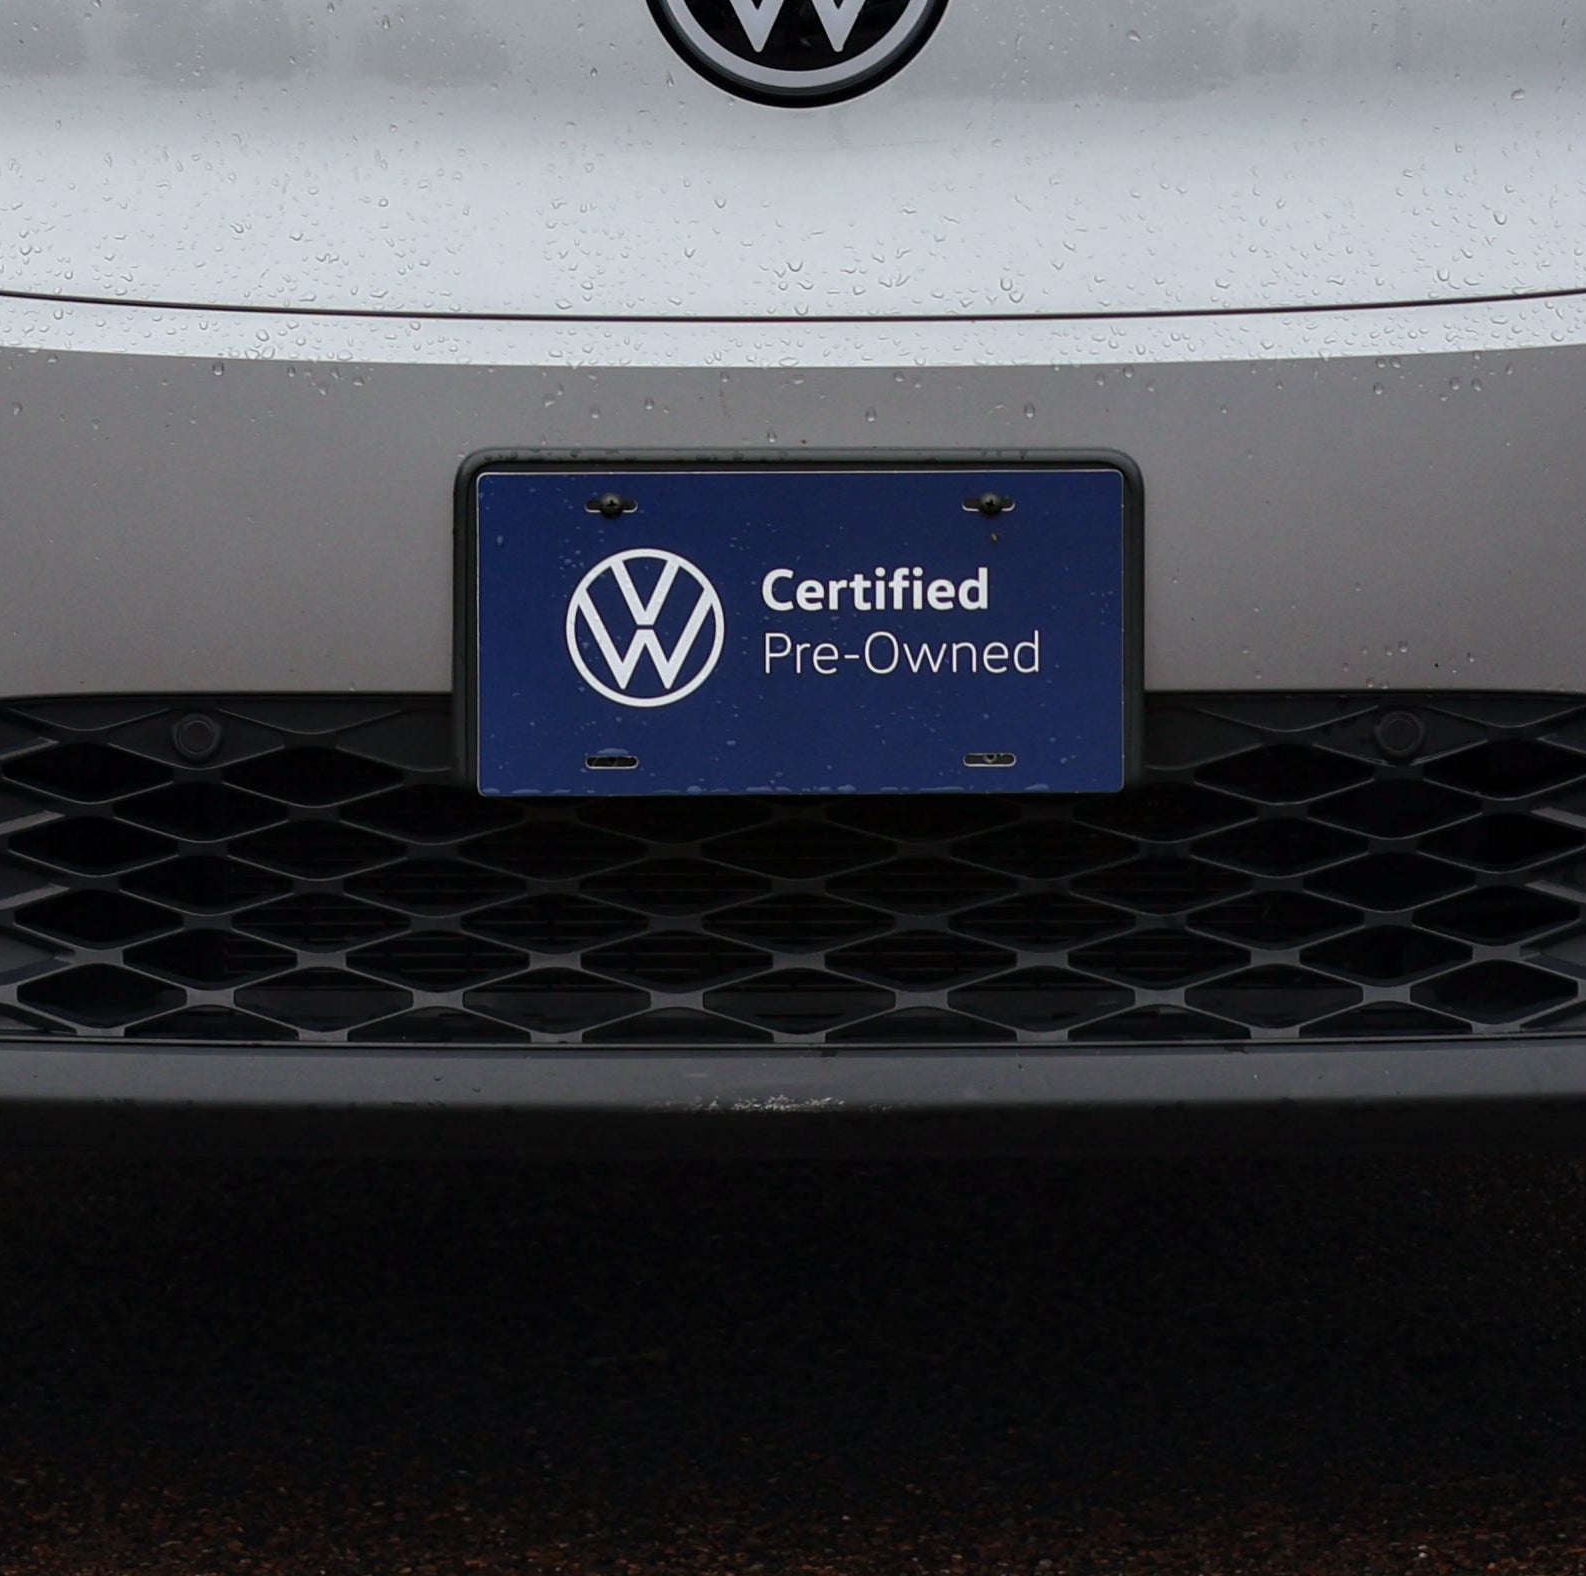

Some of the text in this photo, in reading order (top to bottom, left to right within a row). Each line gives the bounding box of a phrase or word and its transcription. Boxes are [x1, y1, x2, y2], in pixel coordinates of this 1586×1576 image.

[761, 566, 990, 612] Certified
[571, 554, 719, 698] VW
[763, 630, 1041, 675] Pre-Owned
